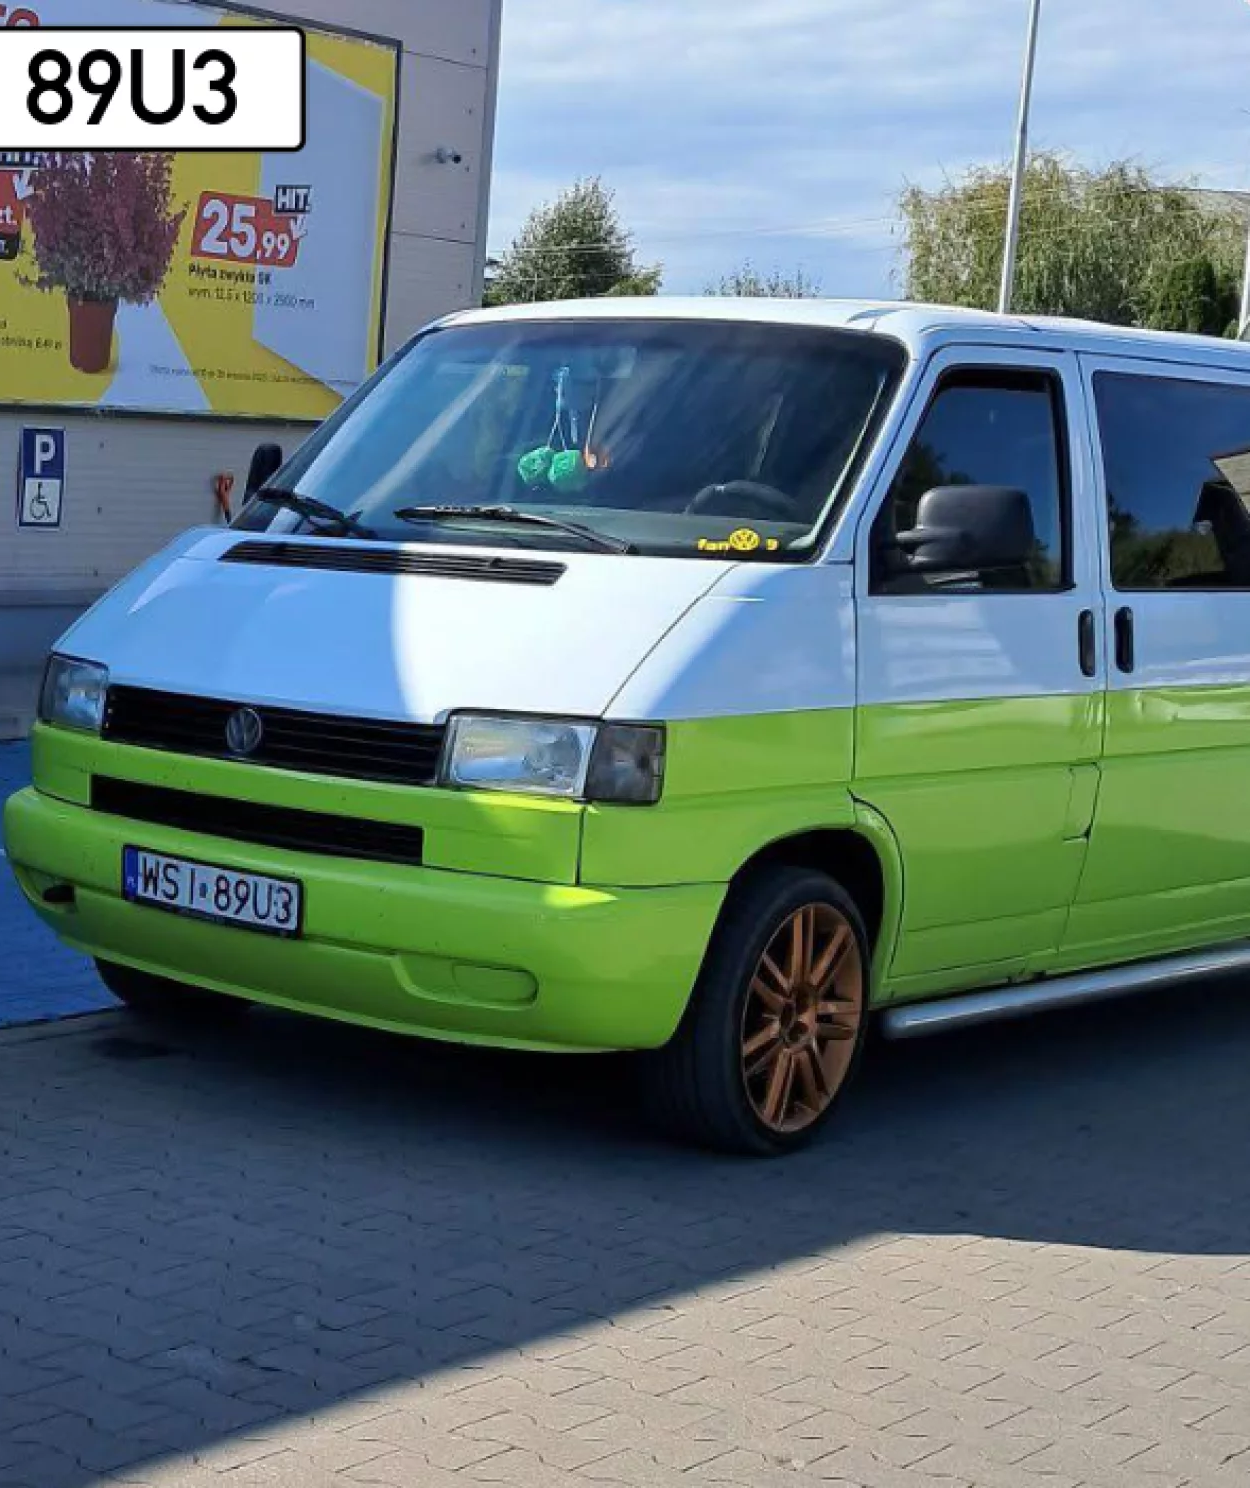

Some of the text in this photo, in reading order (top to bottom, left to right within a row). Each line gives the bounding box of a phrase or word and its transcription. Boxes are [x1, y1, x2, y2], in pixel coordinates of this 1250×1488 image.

[201, 198, 290, 260] 25,99
[35, 434, 56, 474] P
[141, 855, 293, 924] WSI 89U3
